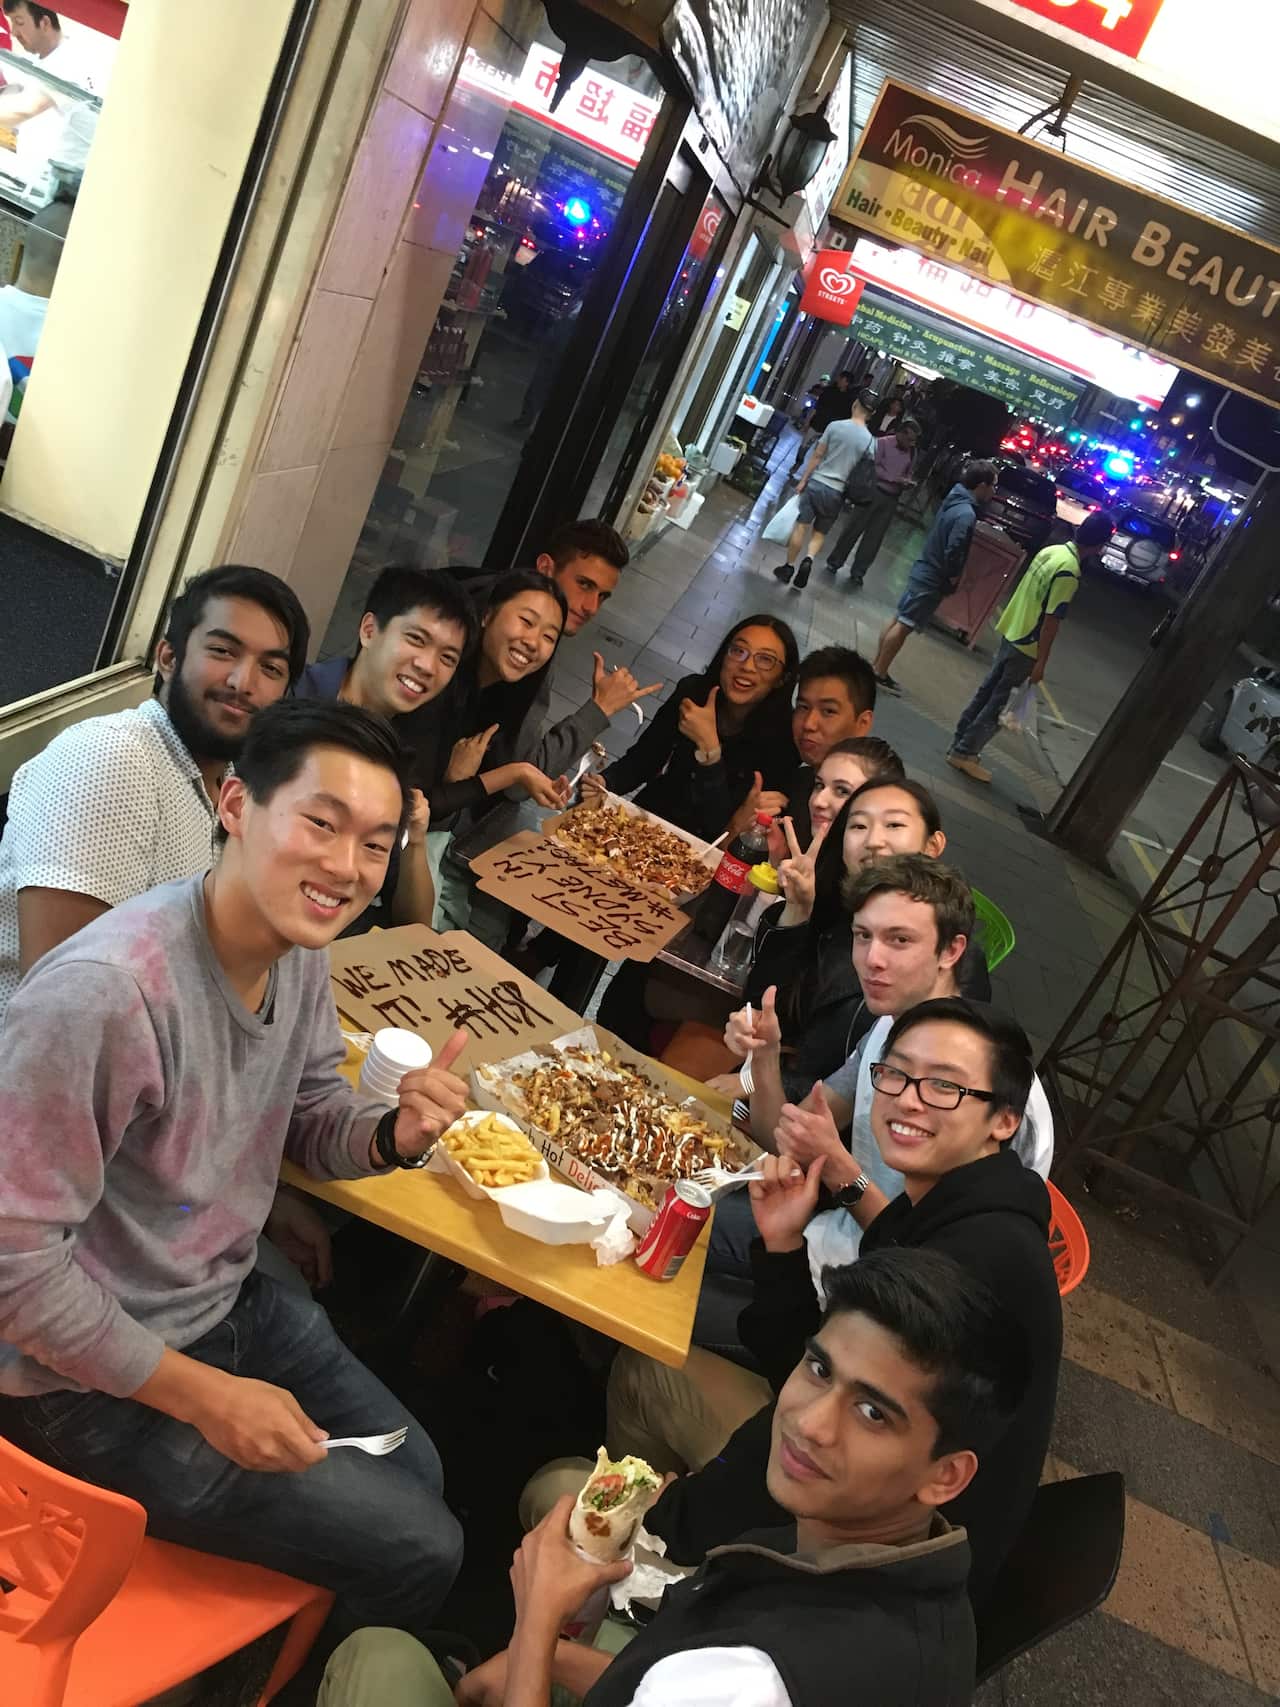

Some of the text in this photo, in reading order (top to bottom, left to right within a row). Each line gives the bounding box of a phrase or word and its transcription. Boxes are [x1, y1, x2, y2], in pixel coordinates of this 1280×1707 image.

[882, 129, 983, 190] Monica
[845, 188, 883, 218] Hair
[890, 207, 949, 250] Beauty
[958, 237, 995, 267] Nail
[995, 159, 1118, 248] HAIR
[817, 289, 846, 305] STREETS
[1026, 245, 1280, 382] 滬江專業美發美
[875, 309, 913, 332] Medicine
[921, 329, 976, 357] Acupuncture
[983, 354, 1021, 376] Massage
[1028, 373, 1079, 402] Reflexology
[531, 892, 642, 949] BEST
[331, 948, 473, 999] WE MADE
[540, 1137, 565, 1167] Hot
